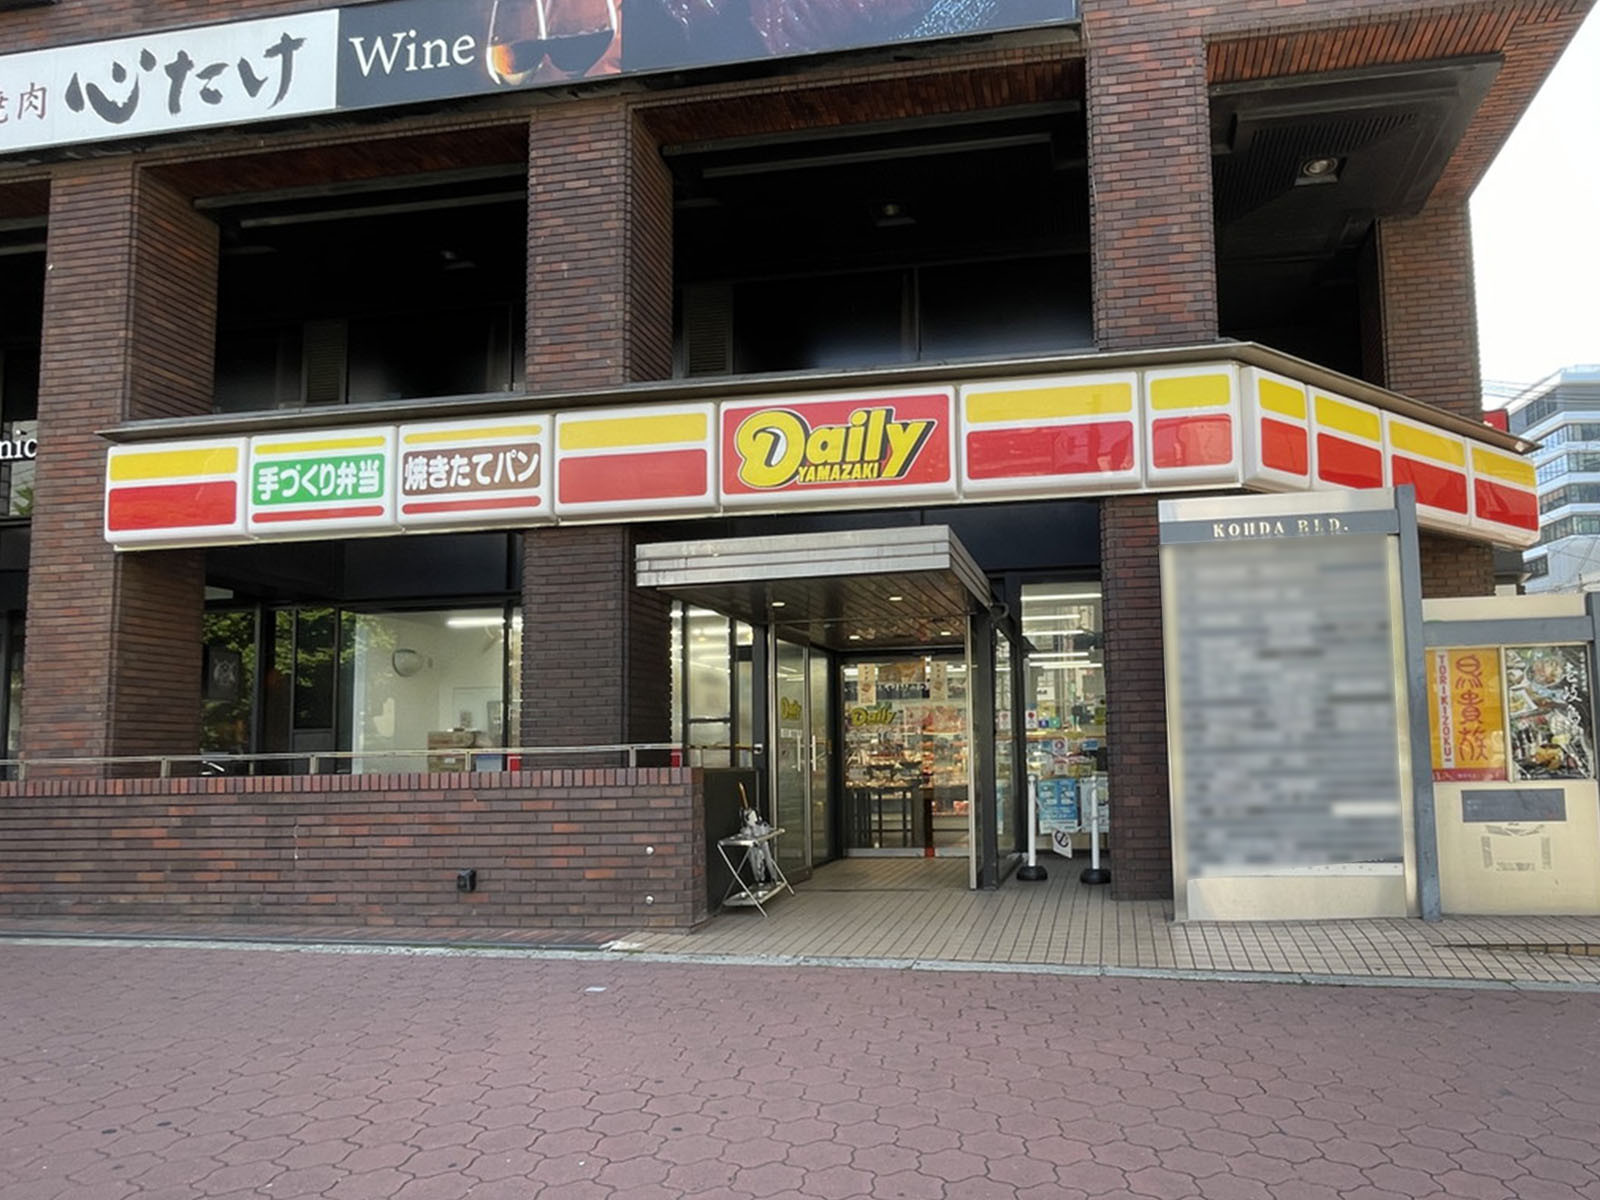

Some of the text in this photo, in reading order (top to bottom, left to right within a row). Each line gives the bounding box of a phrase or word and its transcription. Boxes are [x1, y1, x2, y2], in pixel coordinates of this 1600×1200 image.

[348, 29, 476, 77] Wine
[735, 408, 937, 488] Daily
[257, 459, 380, 501] 手づくり弁当
[404, 448, 539, 491] 焼きたてパン
[798, 461, 881, 483] YAMAZAKI
[1212, 521, 1285, 538] KOHDA
